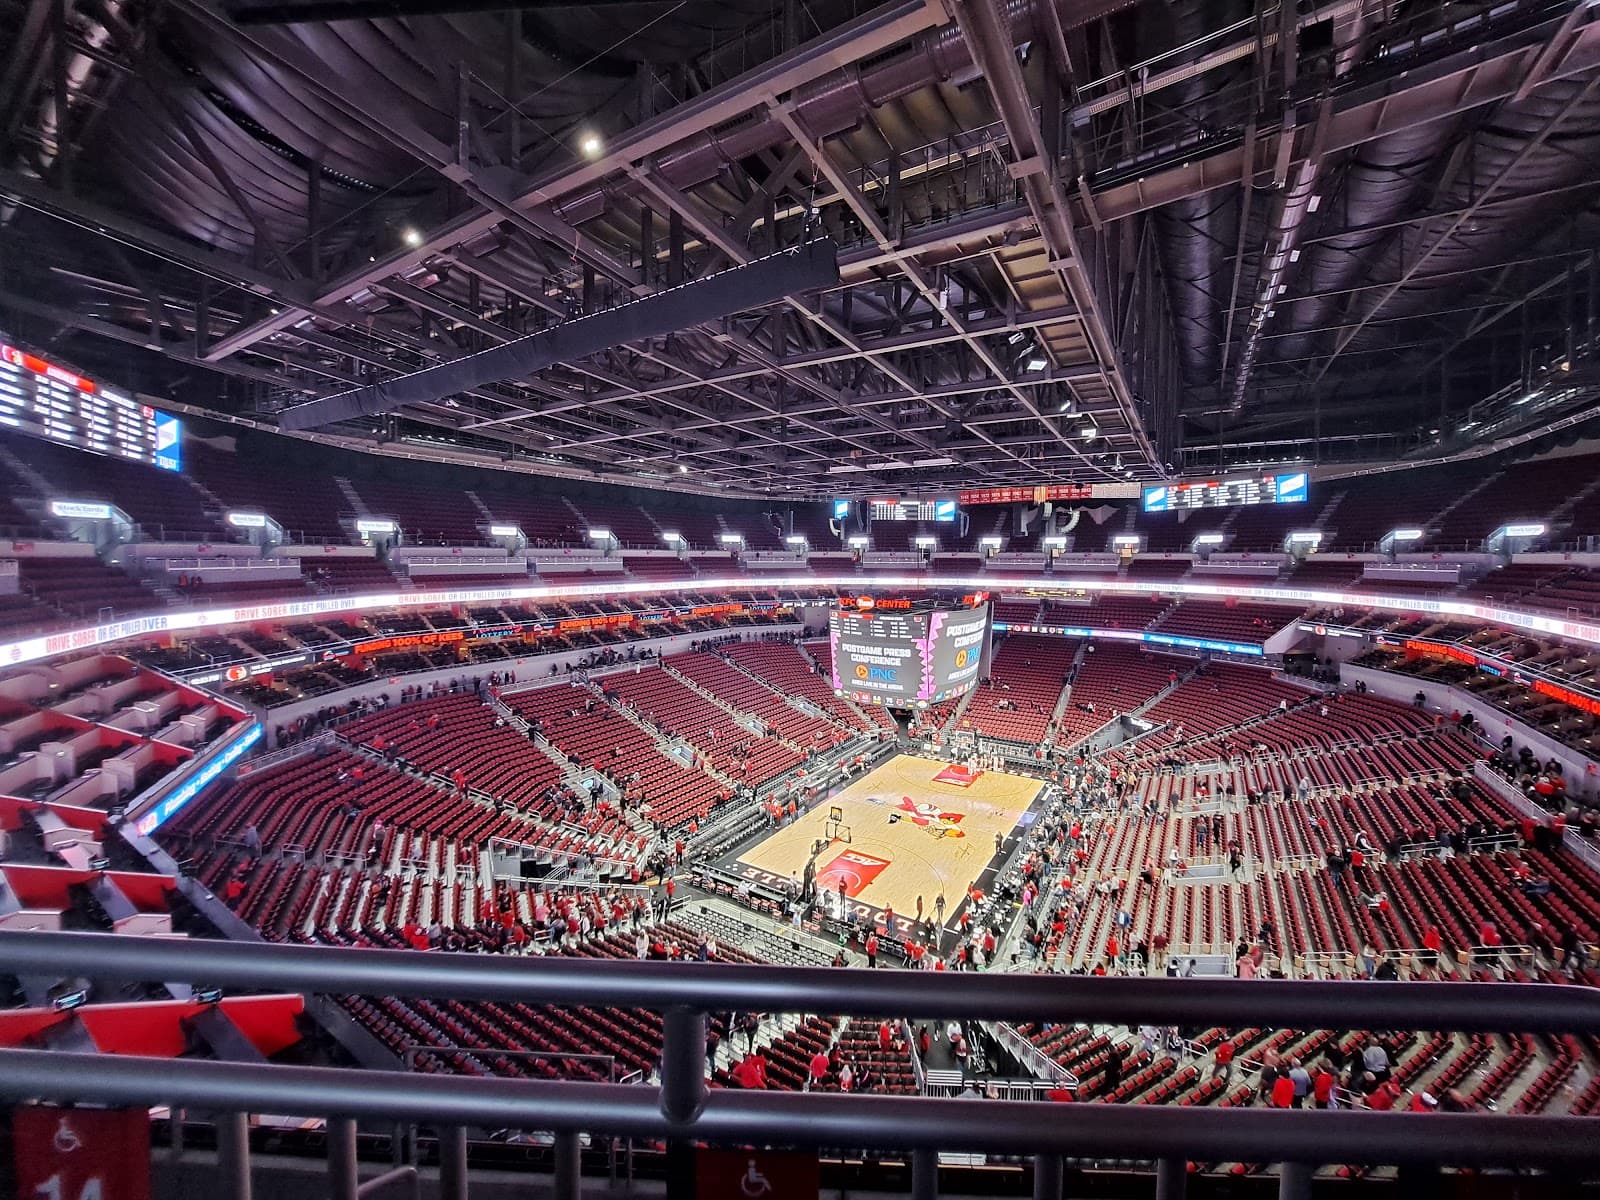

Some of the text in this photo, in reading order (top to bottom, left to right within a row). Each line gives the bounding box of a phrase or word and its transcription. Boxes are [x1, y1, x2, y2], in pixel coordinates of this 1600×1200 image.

[234, 599, 355, 621] DRIVE SOBER OR GET PULLED OVER
[839, 598, 856, 607] KFC
[876, 600, 911, 609] CENTER
[560, 620, 591, 630] FUNDING
[592, 617, 609, 627] 100%
[609, 616, 618, 624] OF
[46, 616, 168, 653] DRIVE SOBER OR GET PULLED OVER
[476, 630, 513, 638] LOTTERY
[355, 640, 391, 654] FUNDING
[393, 636, 420, 647] 100%
[422, 634, 437, 645] OF
[842, 643, 911, 657] POSTGAME PRESS
[1406, 640, 1447, 654] FUNDING
[851, 654, 901, 666] CONFERENCE
[870, 668, 896, 681] PNC
[1536, 680, 1568, 701] FUNDING
[1568, 692, 1590, 711] 100%
[839, 852, 887, 866] ACC
